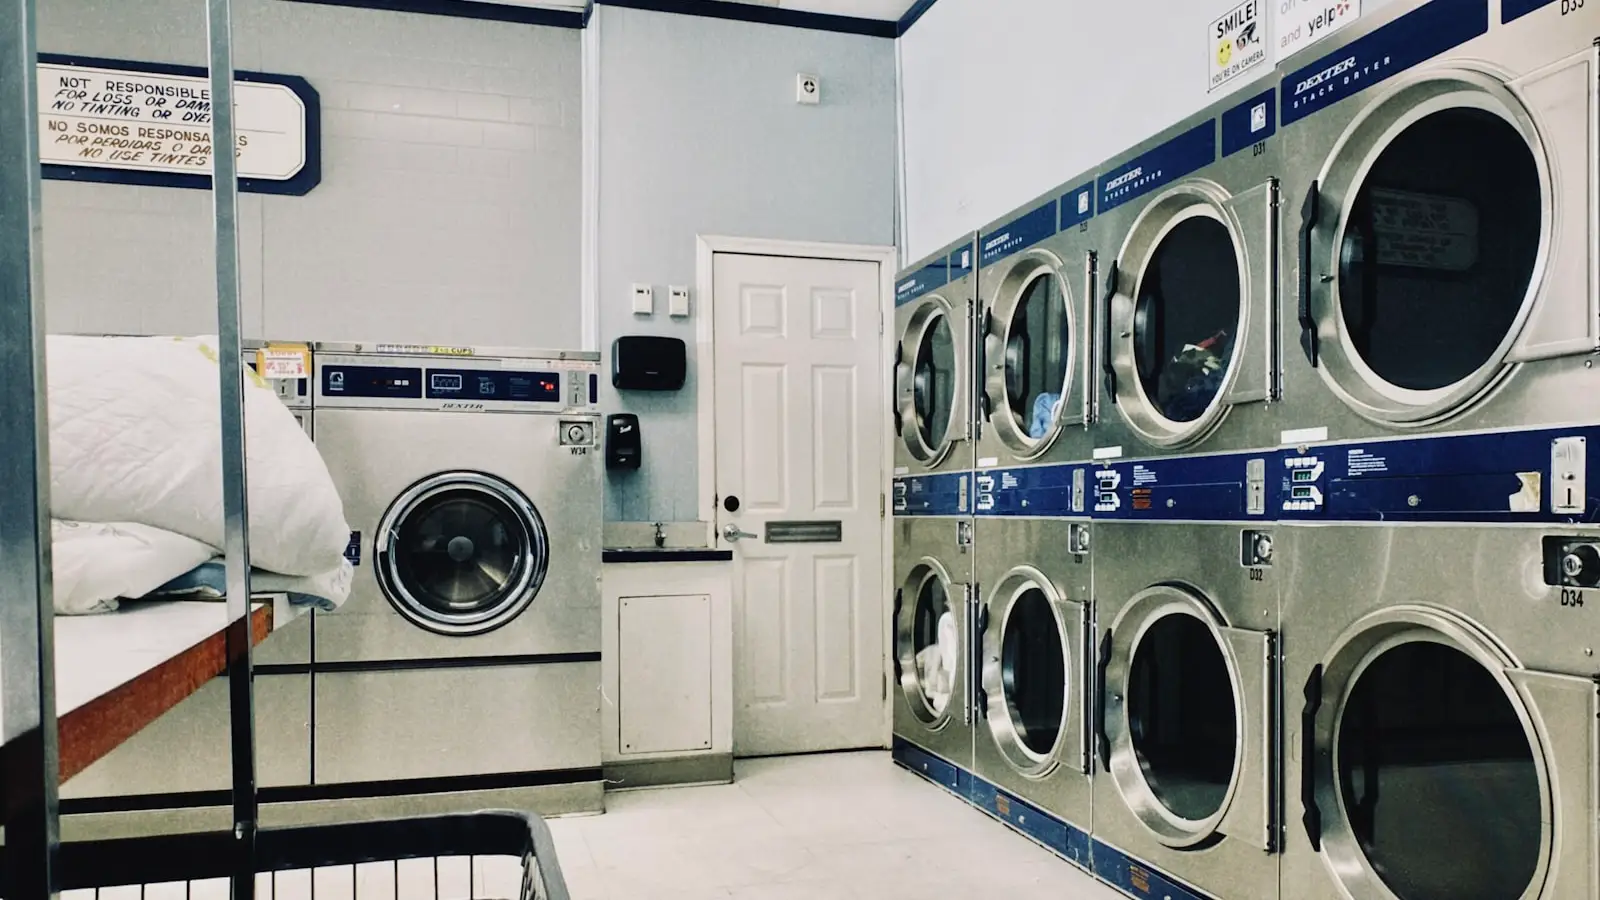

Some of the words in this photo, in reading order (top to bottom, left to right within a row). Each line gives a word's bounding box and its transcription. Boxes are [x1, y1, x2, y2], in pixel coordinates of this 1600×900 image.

[1217, 0, 1257, 39] SMILE!
[1280, 25, 1301, 48] and
[1308, 7, 1336, 37] yelp
[1231, 64, 1240, 74] ON
[1241, 49, 1264, 68] CAMERA
[1293, 83, 1334, 109] STACK
[1344, 56, 1390, 85] DRYER
[1294, 56, 1356, 95] DEXTER
[60, 76, 91, 89] NOT
[106, 80, 210, 100] RESPONSIBLE
[54, 88, 87, 100] FOR
[92, 92, 133, 105] LOSS
[145, 96, 167, 108] OR
[51, 100, 75, 111] NO
[80, 102, 140, 117] TINTING
[152, 109, 172, 119] OR
[48, 120, 68, 132] NO
[76, 122, 129, 136] SOMOS
[55, 134, 89, 146] POR
[91, 137, 162, 151] PERDIDAS
[172, 143, 183, 152] O
[1253, 140, 1266, 157] D31
[79, 147, 103, 158] NO
[109, 150, 144, 161] USE
[150, 152, 207, 166] TINTES
[1105, 166, 1142, 192] DEXTER
[571, 447, 586, 456] W34
[1250, 568, 1263, 581] D32
[1560, 589, 1584, 607] D34
